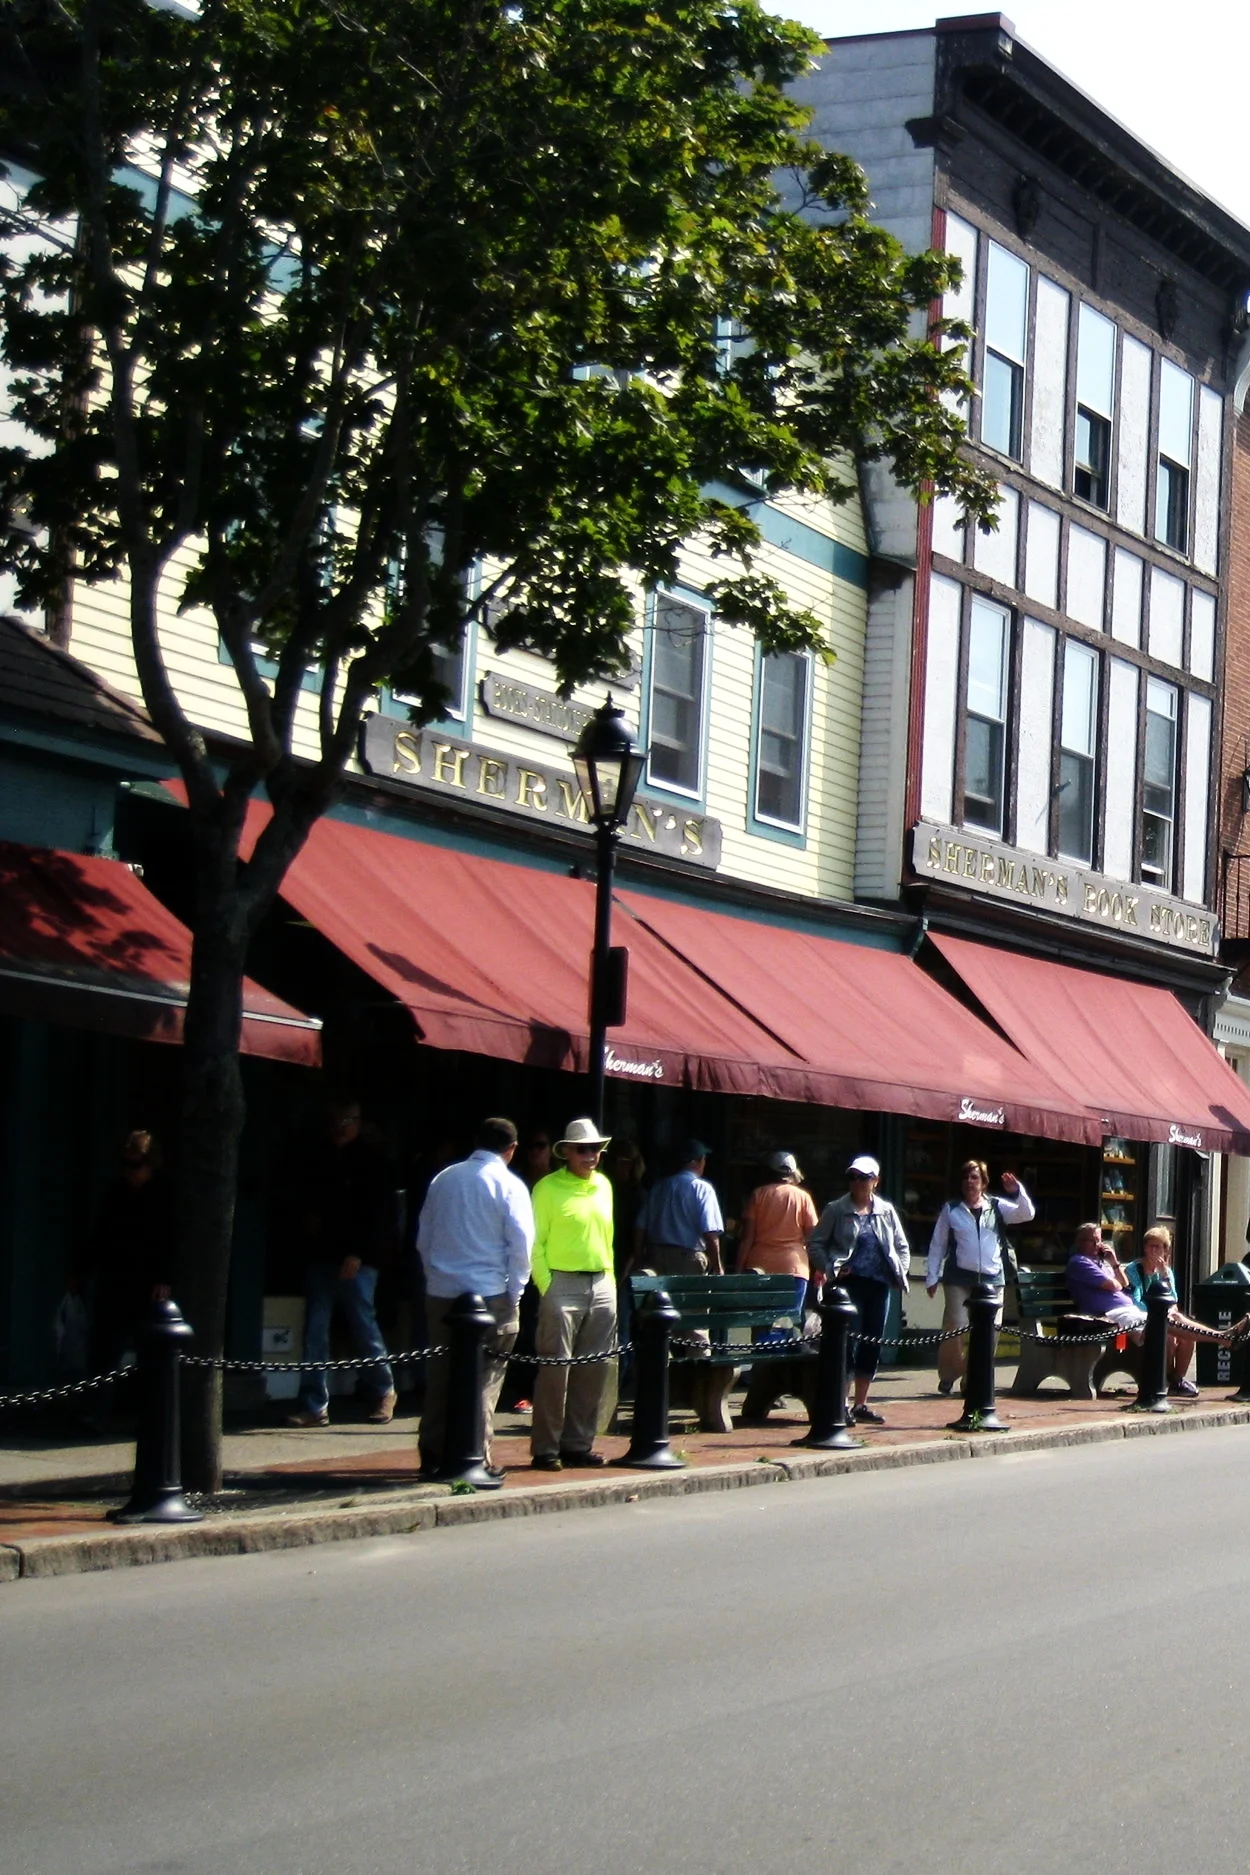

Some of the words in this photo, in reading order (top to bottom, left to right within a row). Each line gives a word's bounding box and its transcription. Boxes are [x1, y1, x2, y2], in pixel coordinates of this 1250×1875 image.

[393, 730, 703, 856] SHERMN'S
[927, 837, 1069, 905] SHERMAN'S
[1082, 882, 1139, 926] BOOK
[1150, 904, 1211, 947] STORE
[604, 1046, 664, 1078] herman's
[958, 1098, 1006, 1125] Sherman's
[1217, 1311, 1232, 1381] RECLE
